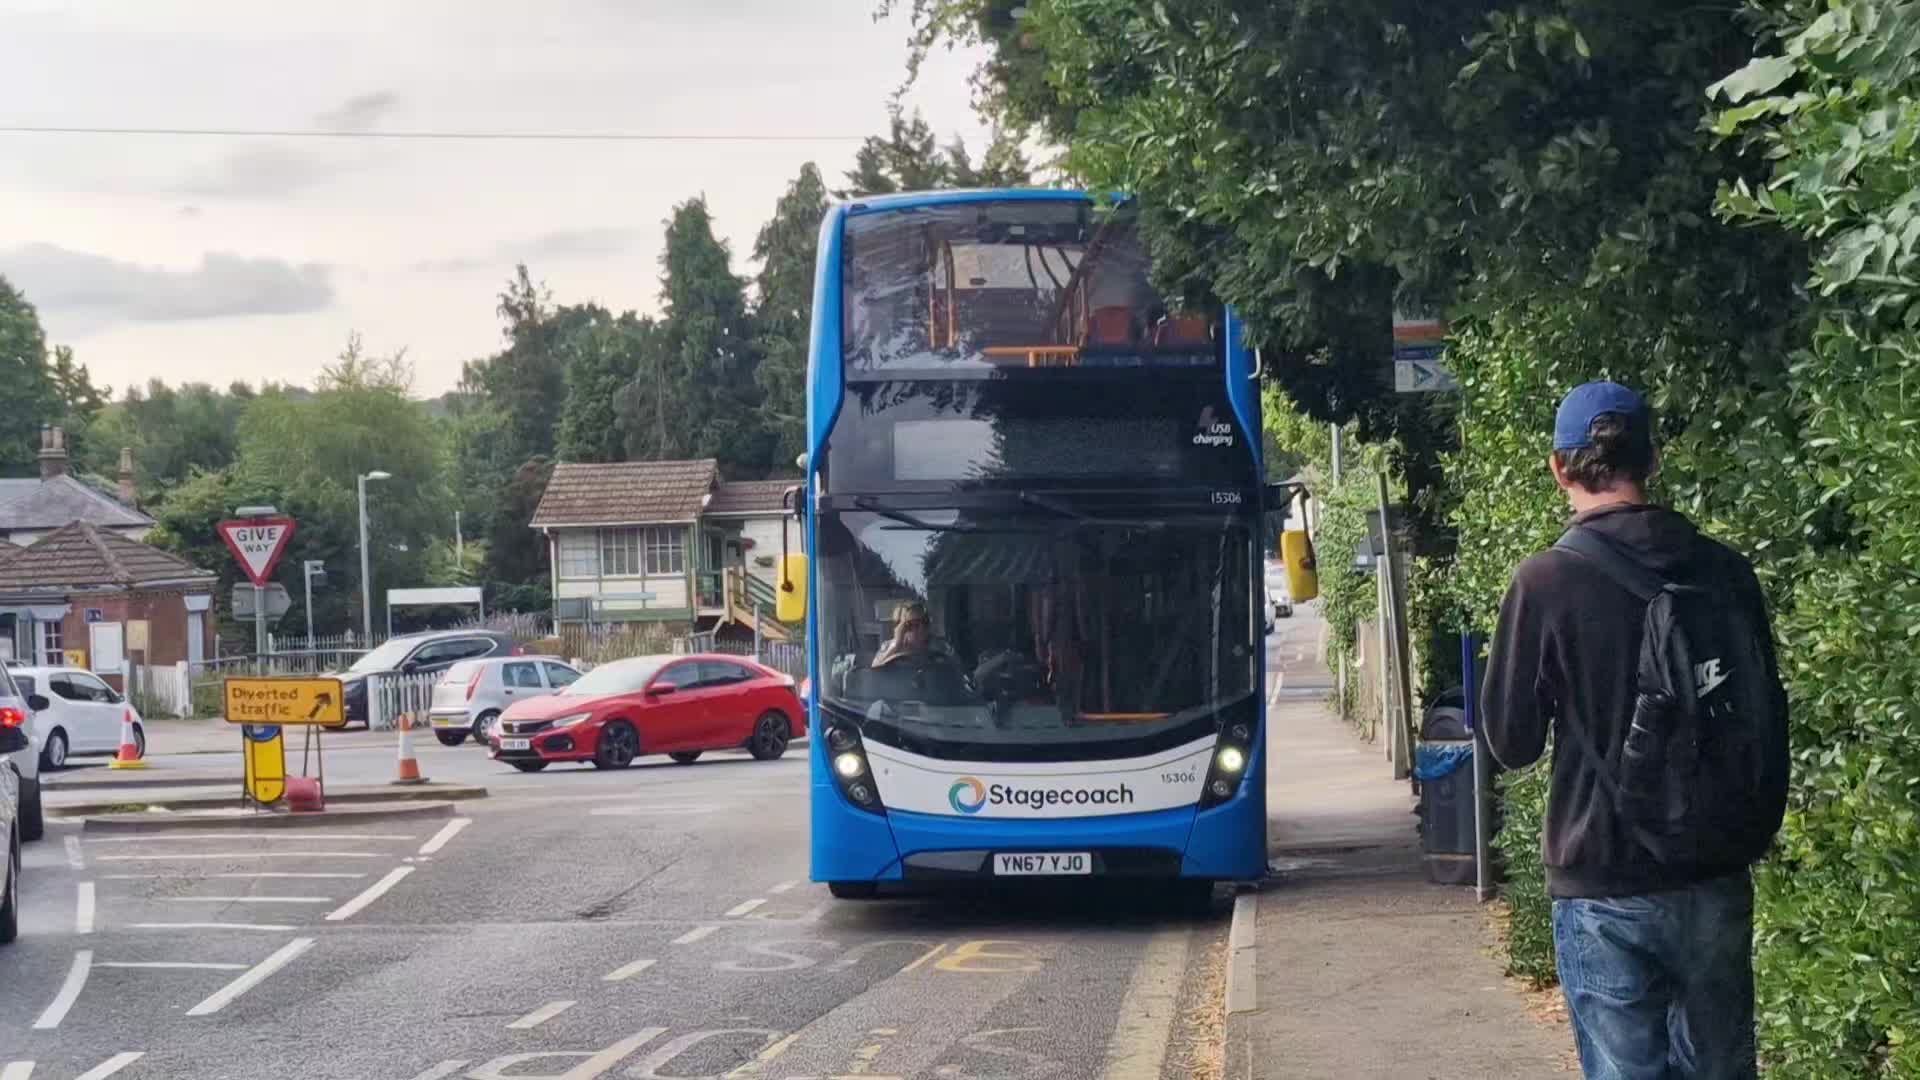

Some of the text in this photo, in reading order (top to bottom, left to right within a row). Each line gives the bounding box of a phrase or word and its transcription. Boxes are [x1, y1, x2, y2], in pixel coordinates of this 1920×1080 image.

[1210, 423, 1231, 433] USB
[1192, 432, 1233, 447] charging
[1211, 491, 1242, 504] 15306
[236, 527, 277, 541] GIVE
[244, 542, 270, 552] WAY
[232, 687, 299, 701] Diverted
[240, 703, 291, 719] traffic
[1161, 773, 1196, 783] 15306
[989, 783, 1134, 810] Stagecoach
[1001, 856, 1045, 872] YN67
